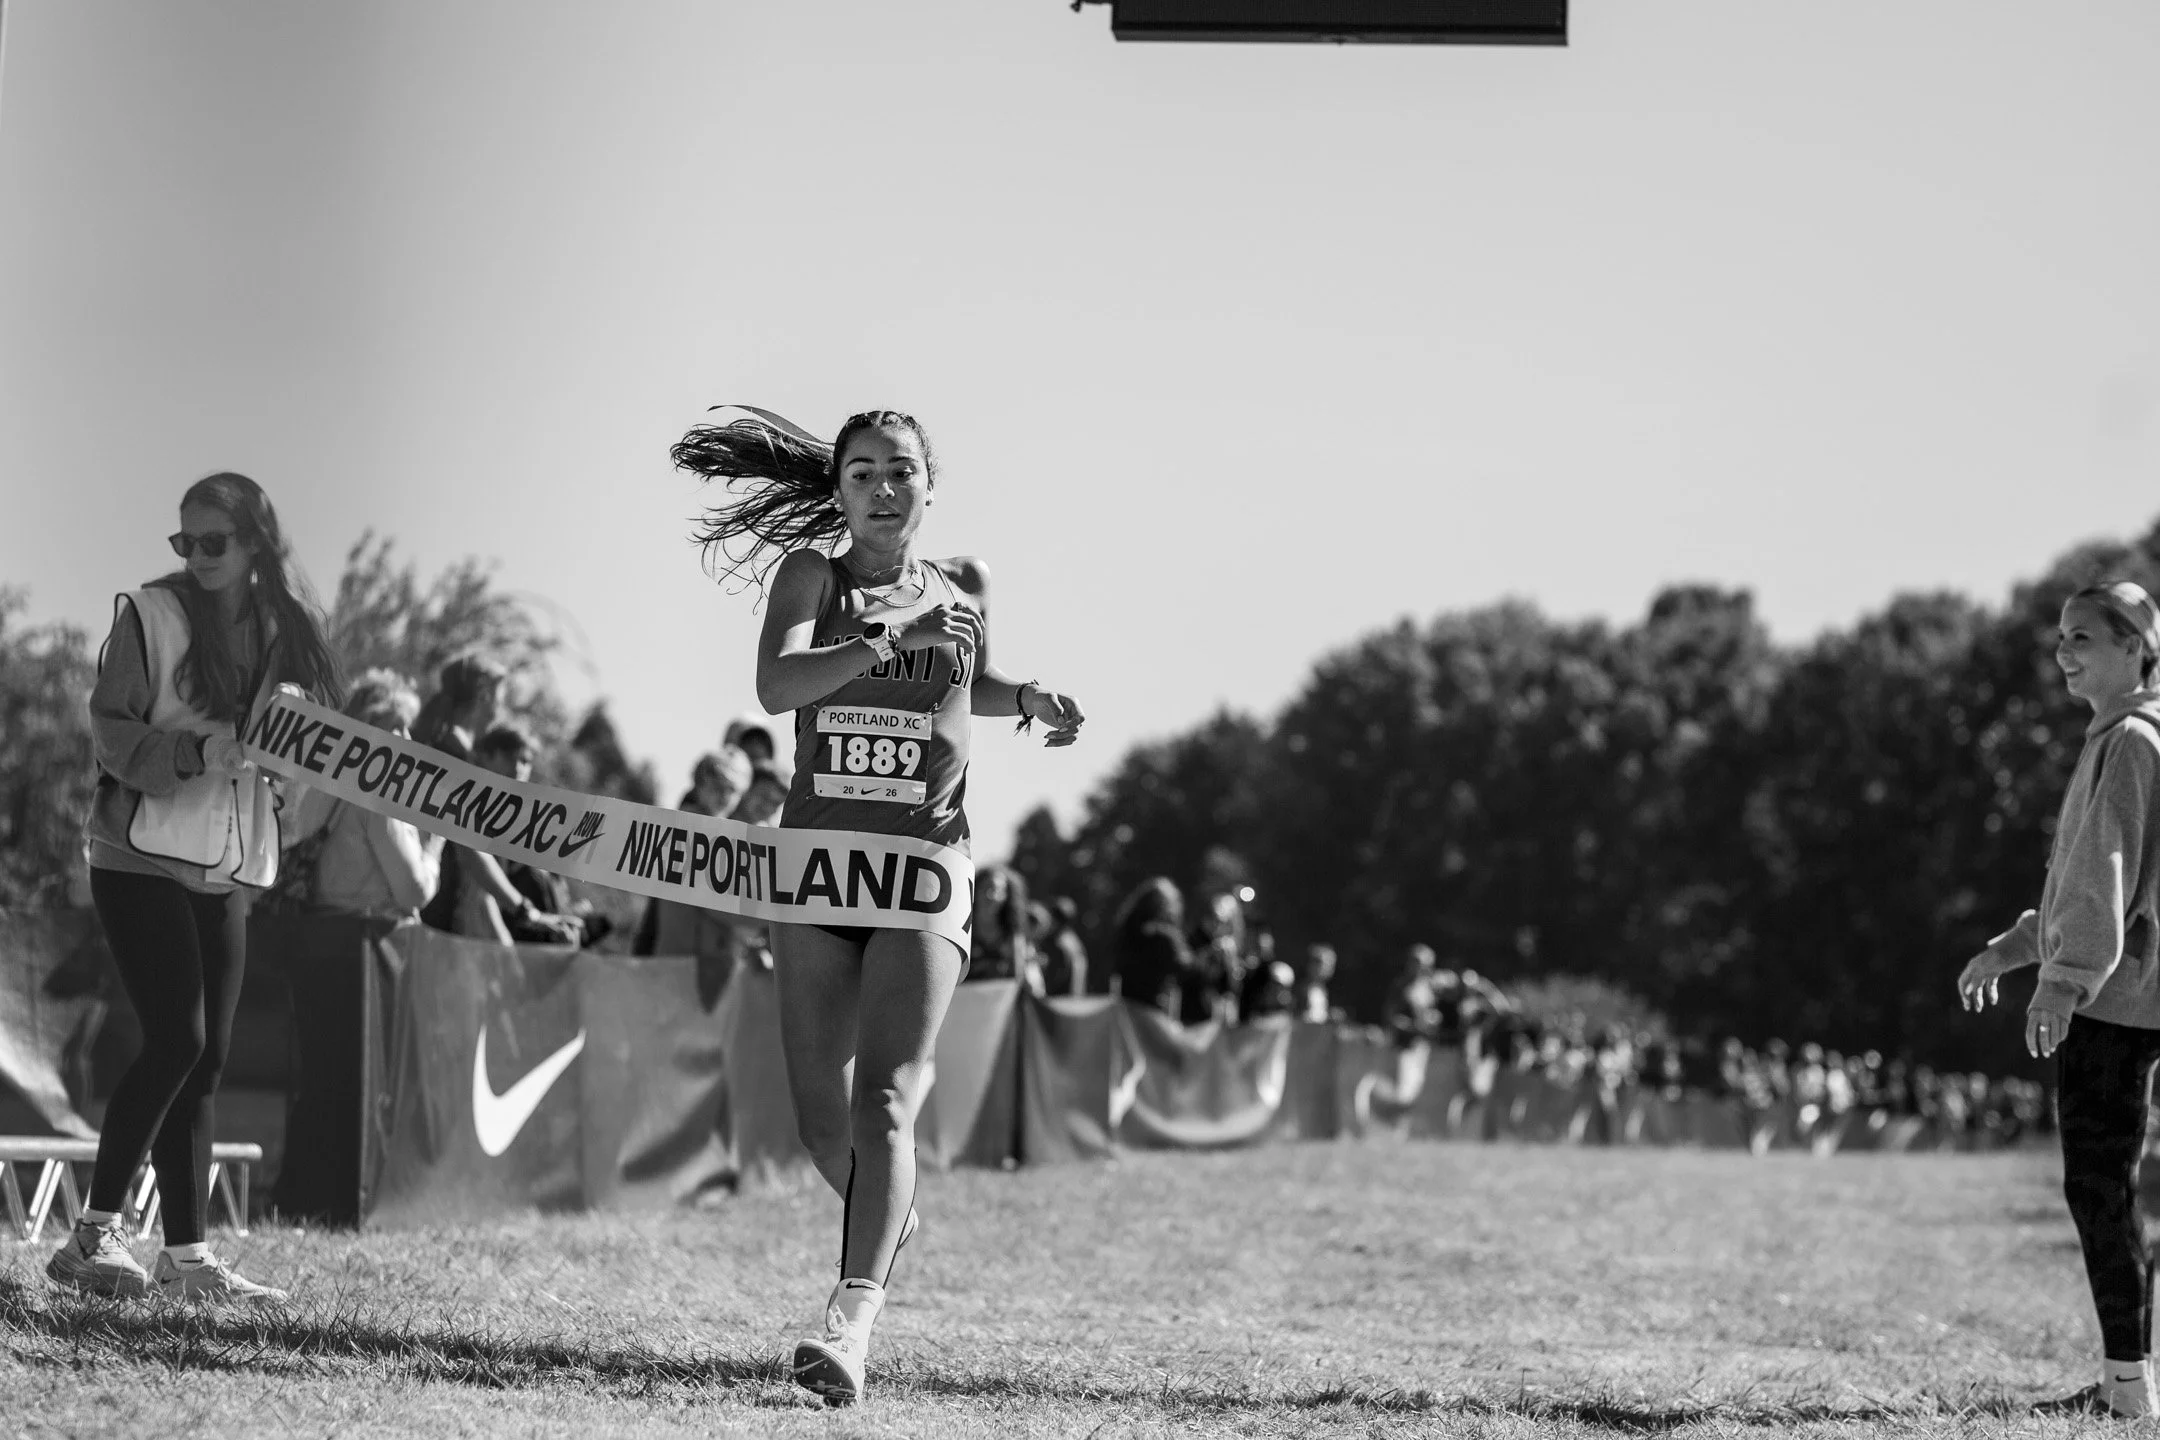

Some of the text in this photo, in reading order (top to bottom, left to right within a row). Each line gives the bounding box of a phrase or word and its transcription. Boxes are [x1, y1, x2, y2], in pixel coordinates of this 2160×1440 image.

[818, 634, 935, 682] UNT
[829, 711, 920, 730] PORTLAND XC
[828, 735, 922, 777] 1889
[247, 703, 567, 853] NIKE PORTLAND XC
[842, 785, 898, 797] 20 26
[573, 810, 606, 838] RUN
[615, 819, 688, 886] NIKE
[688, 834, 952, 915] PORTLAND
